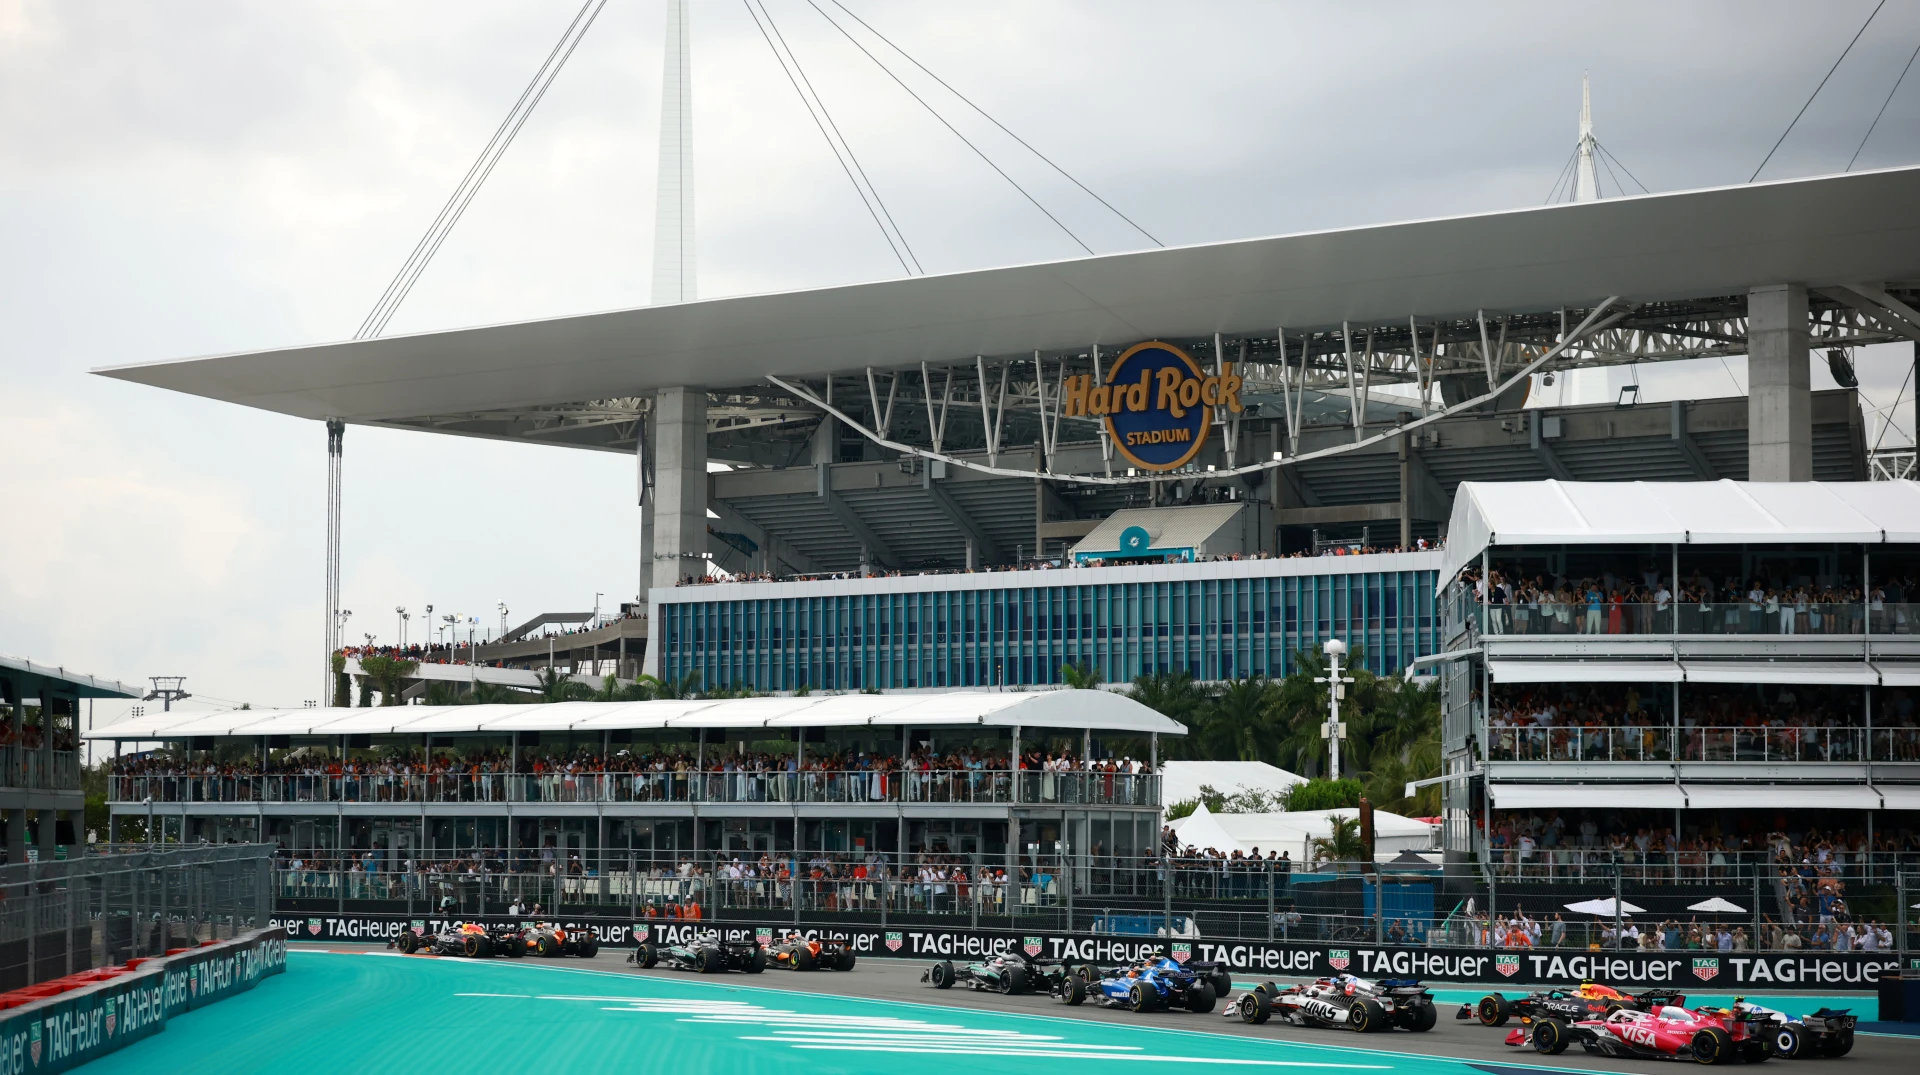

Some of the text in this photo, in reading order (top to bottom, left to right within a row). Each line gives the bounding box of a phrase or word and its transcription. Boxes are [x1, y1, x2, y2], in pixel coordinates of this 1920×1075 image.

[1064, 361, 1243, 419] Hard Rock
[1126, 427, 1191, 446] STADIUM
[326, 919, 406, 937] TAGHeuer
[909, 933, 1017, 956] TAGHeuer
[1049, 938, 1164, 961] TAGHeuer
[1173, 943, 1190, 951] TAG
[1330, 950, 1348, 958] TAG
[1199, 944, 1321, 970] TAGHeuer
[1329, 958, 1349, 968] HEUER
[1358, 950, 1488, 976] TAGHeuer
[1694, 959, 1717, 967] TAG
[1496, 964, 1519, 975] HEUER
[1529, 955, 1681, 981] TAGHeuer
[1693, 968, 1718, 978] HEUER
[1543, 1002, 1579, 1012] ORACLE
[46, 1006, 103, 1062] TAGHeuer
[1621, 1026, 1656, 1048] VISA
